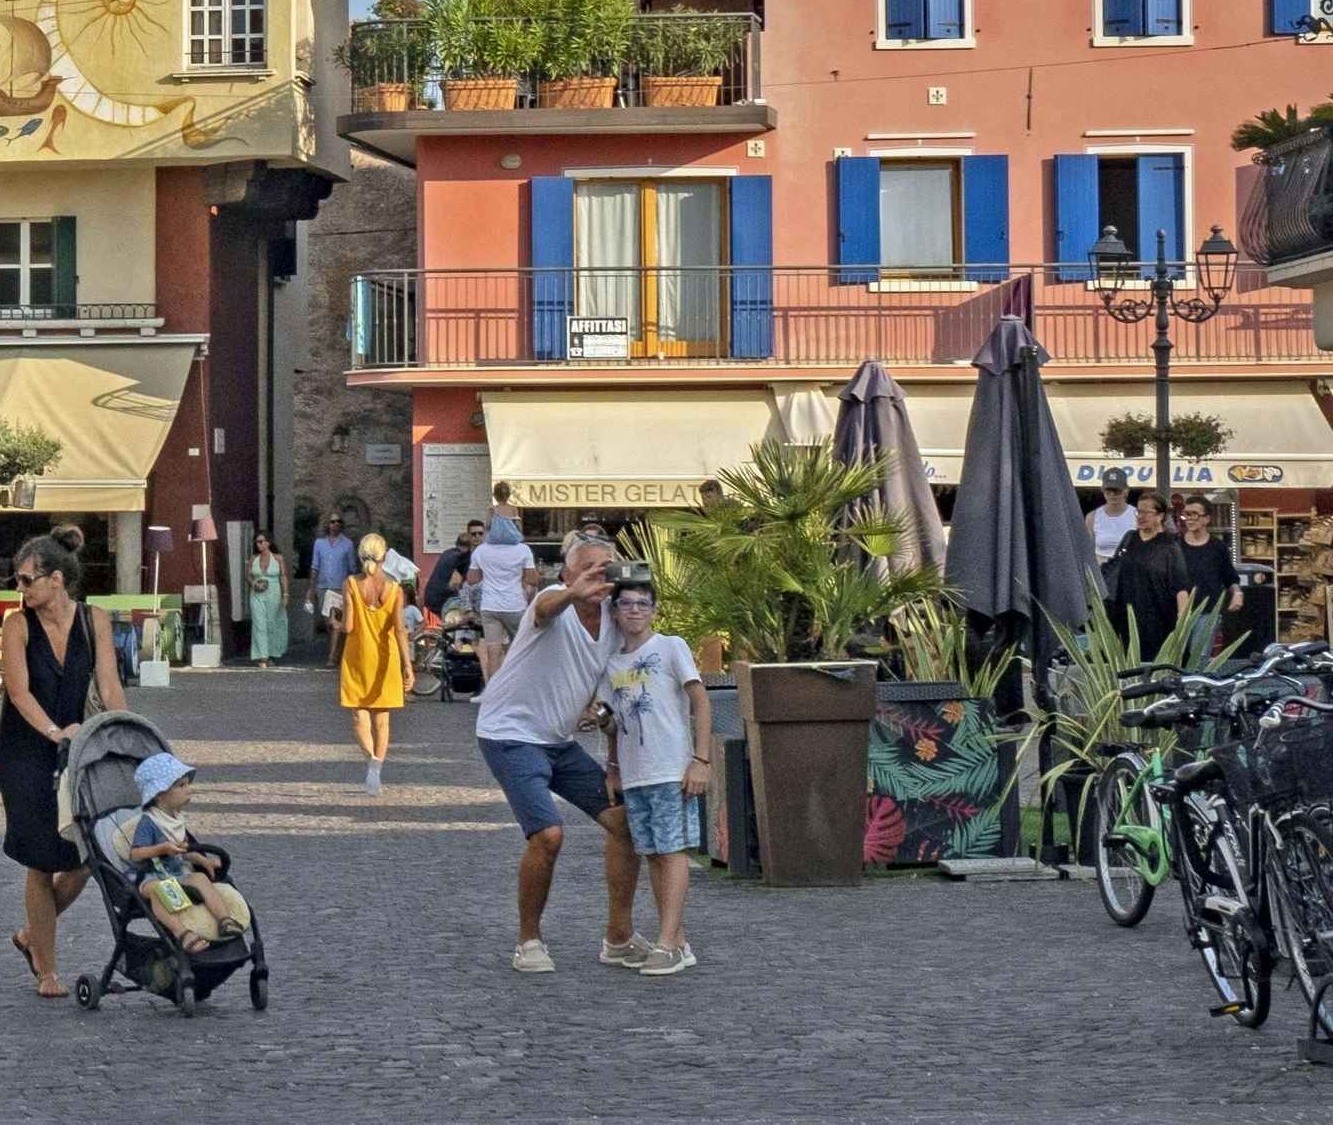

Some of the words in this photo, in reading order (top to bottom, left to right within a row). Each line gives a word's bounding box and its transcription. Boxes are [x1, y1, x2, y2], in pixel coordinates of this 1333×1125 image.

[571, 319, 627, 333] AFFITTASI
[1121, 465, 1213, 482] PULIA
[529, 484, 616, 503] MISTER
[624, 484, 701, 503] GELAT
